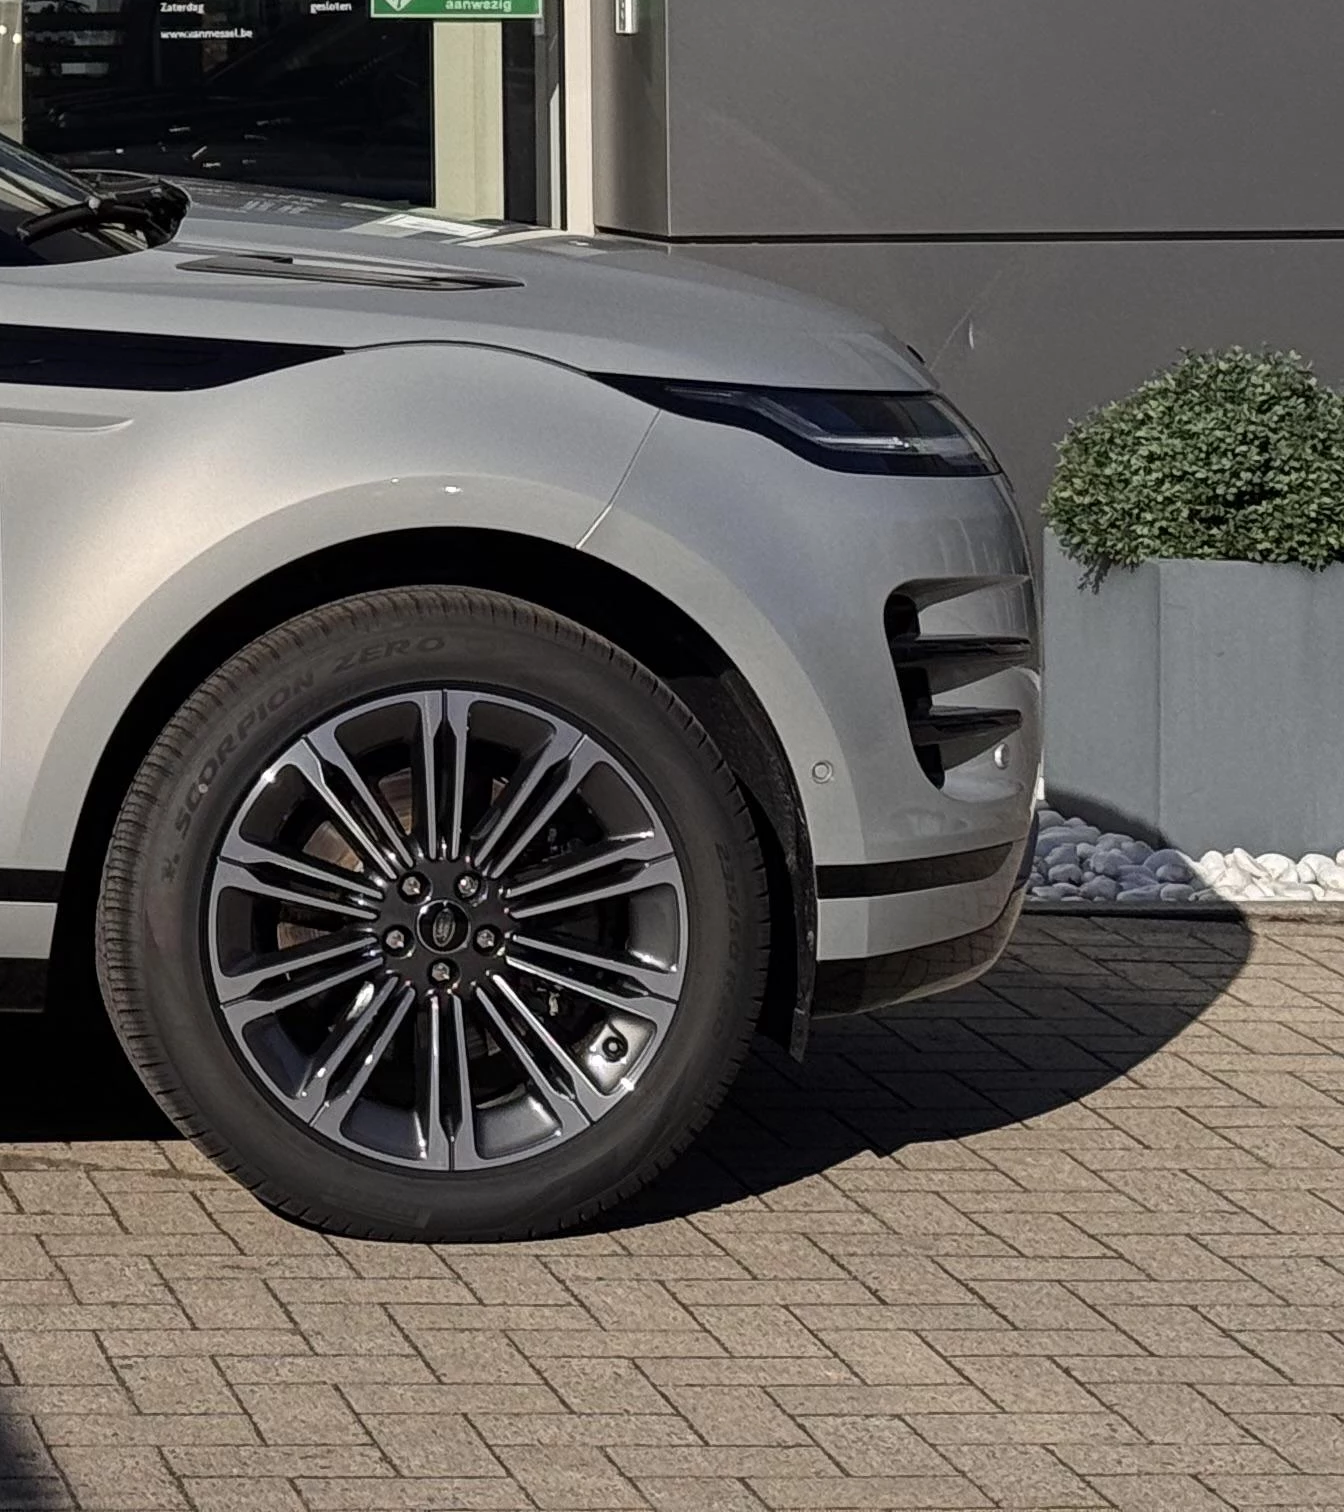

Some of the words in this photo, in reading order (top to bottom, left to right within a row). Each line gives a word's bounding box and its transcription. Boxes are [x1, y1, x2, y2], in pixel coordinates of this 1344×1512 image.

[160, 2, 204, 15] Zaterdag
[176, 671, 315, 840] SCORPION
[332, 636, 446, 674] ZERO
